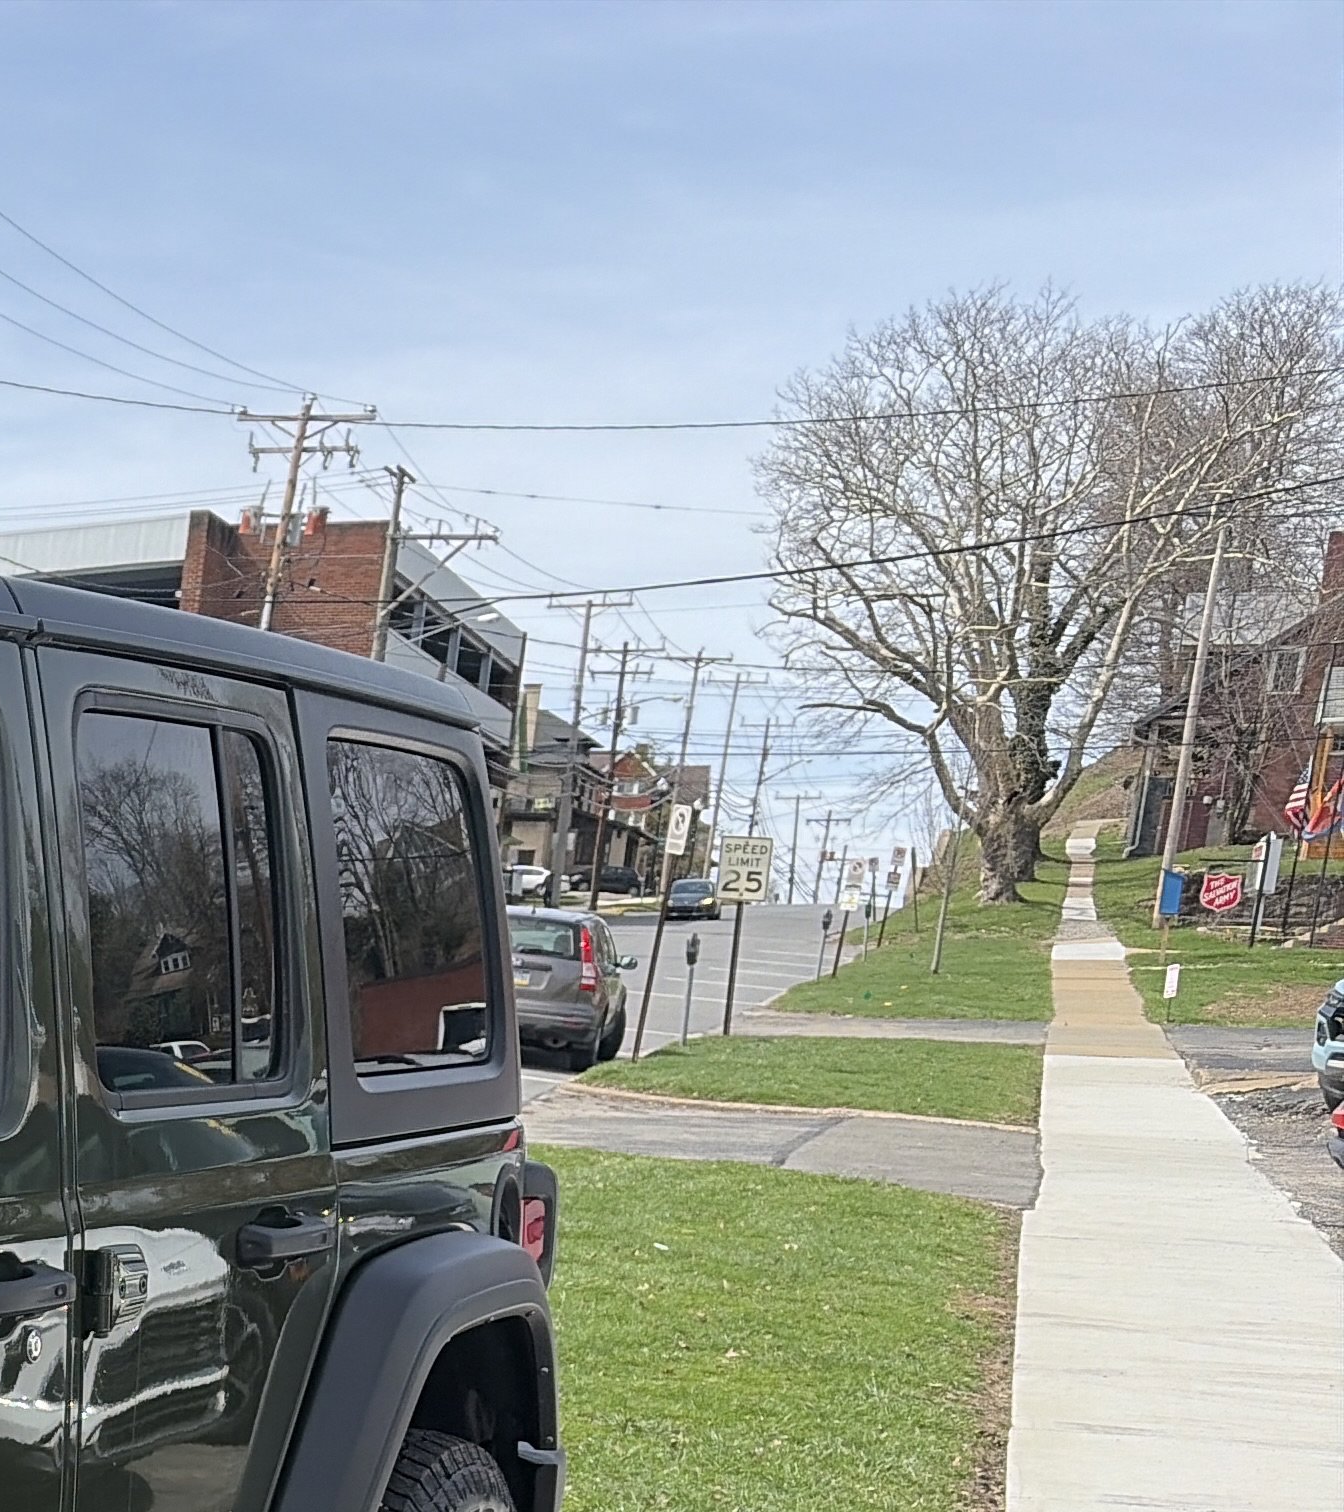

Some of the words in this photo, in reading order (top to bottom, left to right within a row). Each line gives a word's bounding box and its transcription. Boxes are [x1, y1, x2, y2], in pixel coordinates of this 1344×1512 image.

[724, 843, 768, 855] SPEED
[728, 857, 762, 867] LIMIT
[721, 869, 763, 893] 25
[1209, 877, 1226, 890] THE
[1203, 880, 1239, 902] SALVATION
[1213, 890, 1237, 907] ARMY
